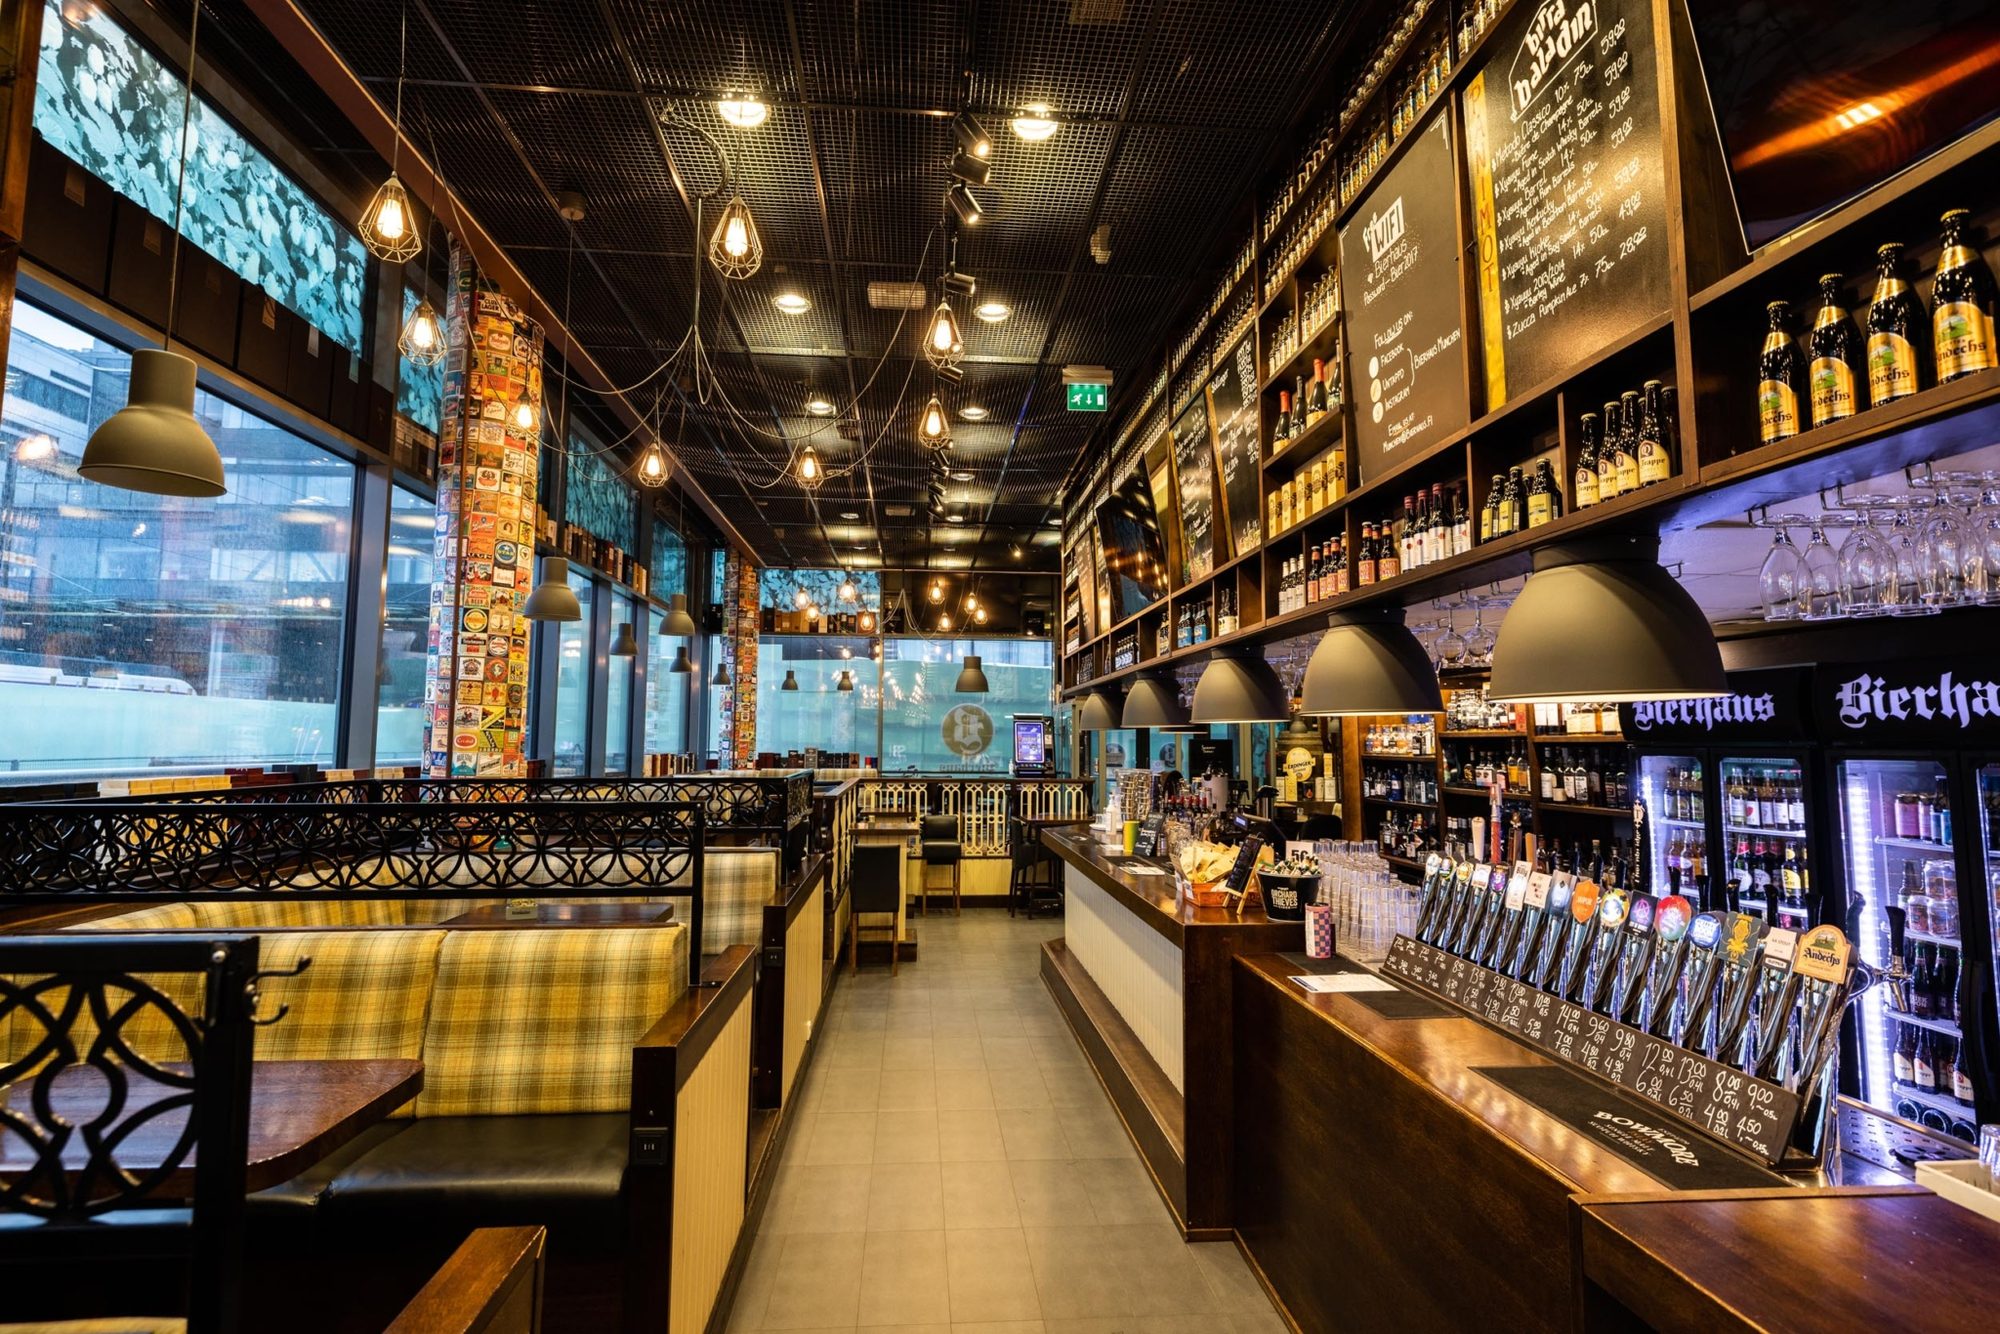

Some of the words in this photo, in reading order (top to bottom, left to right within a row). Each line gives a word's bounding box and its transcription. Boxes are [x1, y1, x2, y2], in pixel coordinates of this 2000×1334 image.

[1514, 3, 1592, 111] baladin
[1522, 104, 1550, 139] Classico
[1374, 204, 1401, 253] WIFI
[1374, 239, 1407, 279] Bierhaus
[1363, 277, 1386, 306] Password
[1381, 343, 1404, 367] FACEBOOK
[1385, 386, 1411, 412] INSTAGRAM
[1632, 691, 1776, 731] Bierhaus
[1835, 671, 2000, 729] Bierha
[1273, 897, 1298, 907] THIEVES
[1802, 947, 1841, 967] Andechs
[1593, 1111, 1699, 1167] BOWMORE
